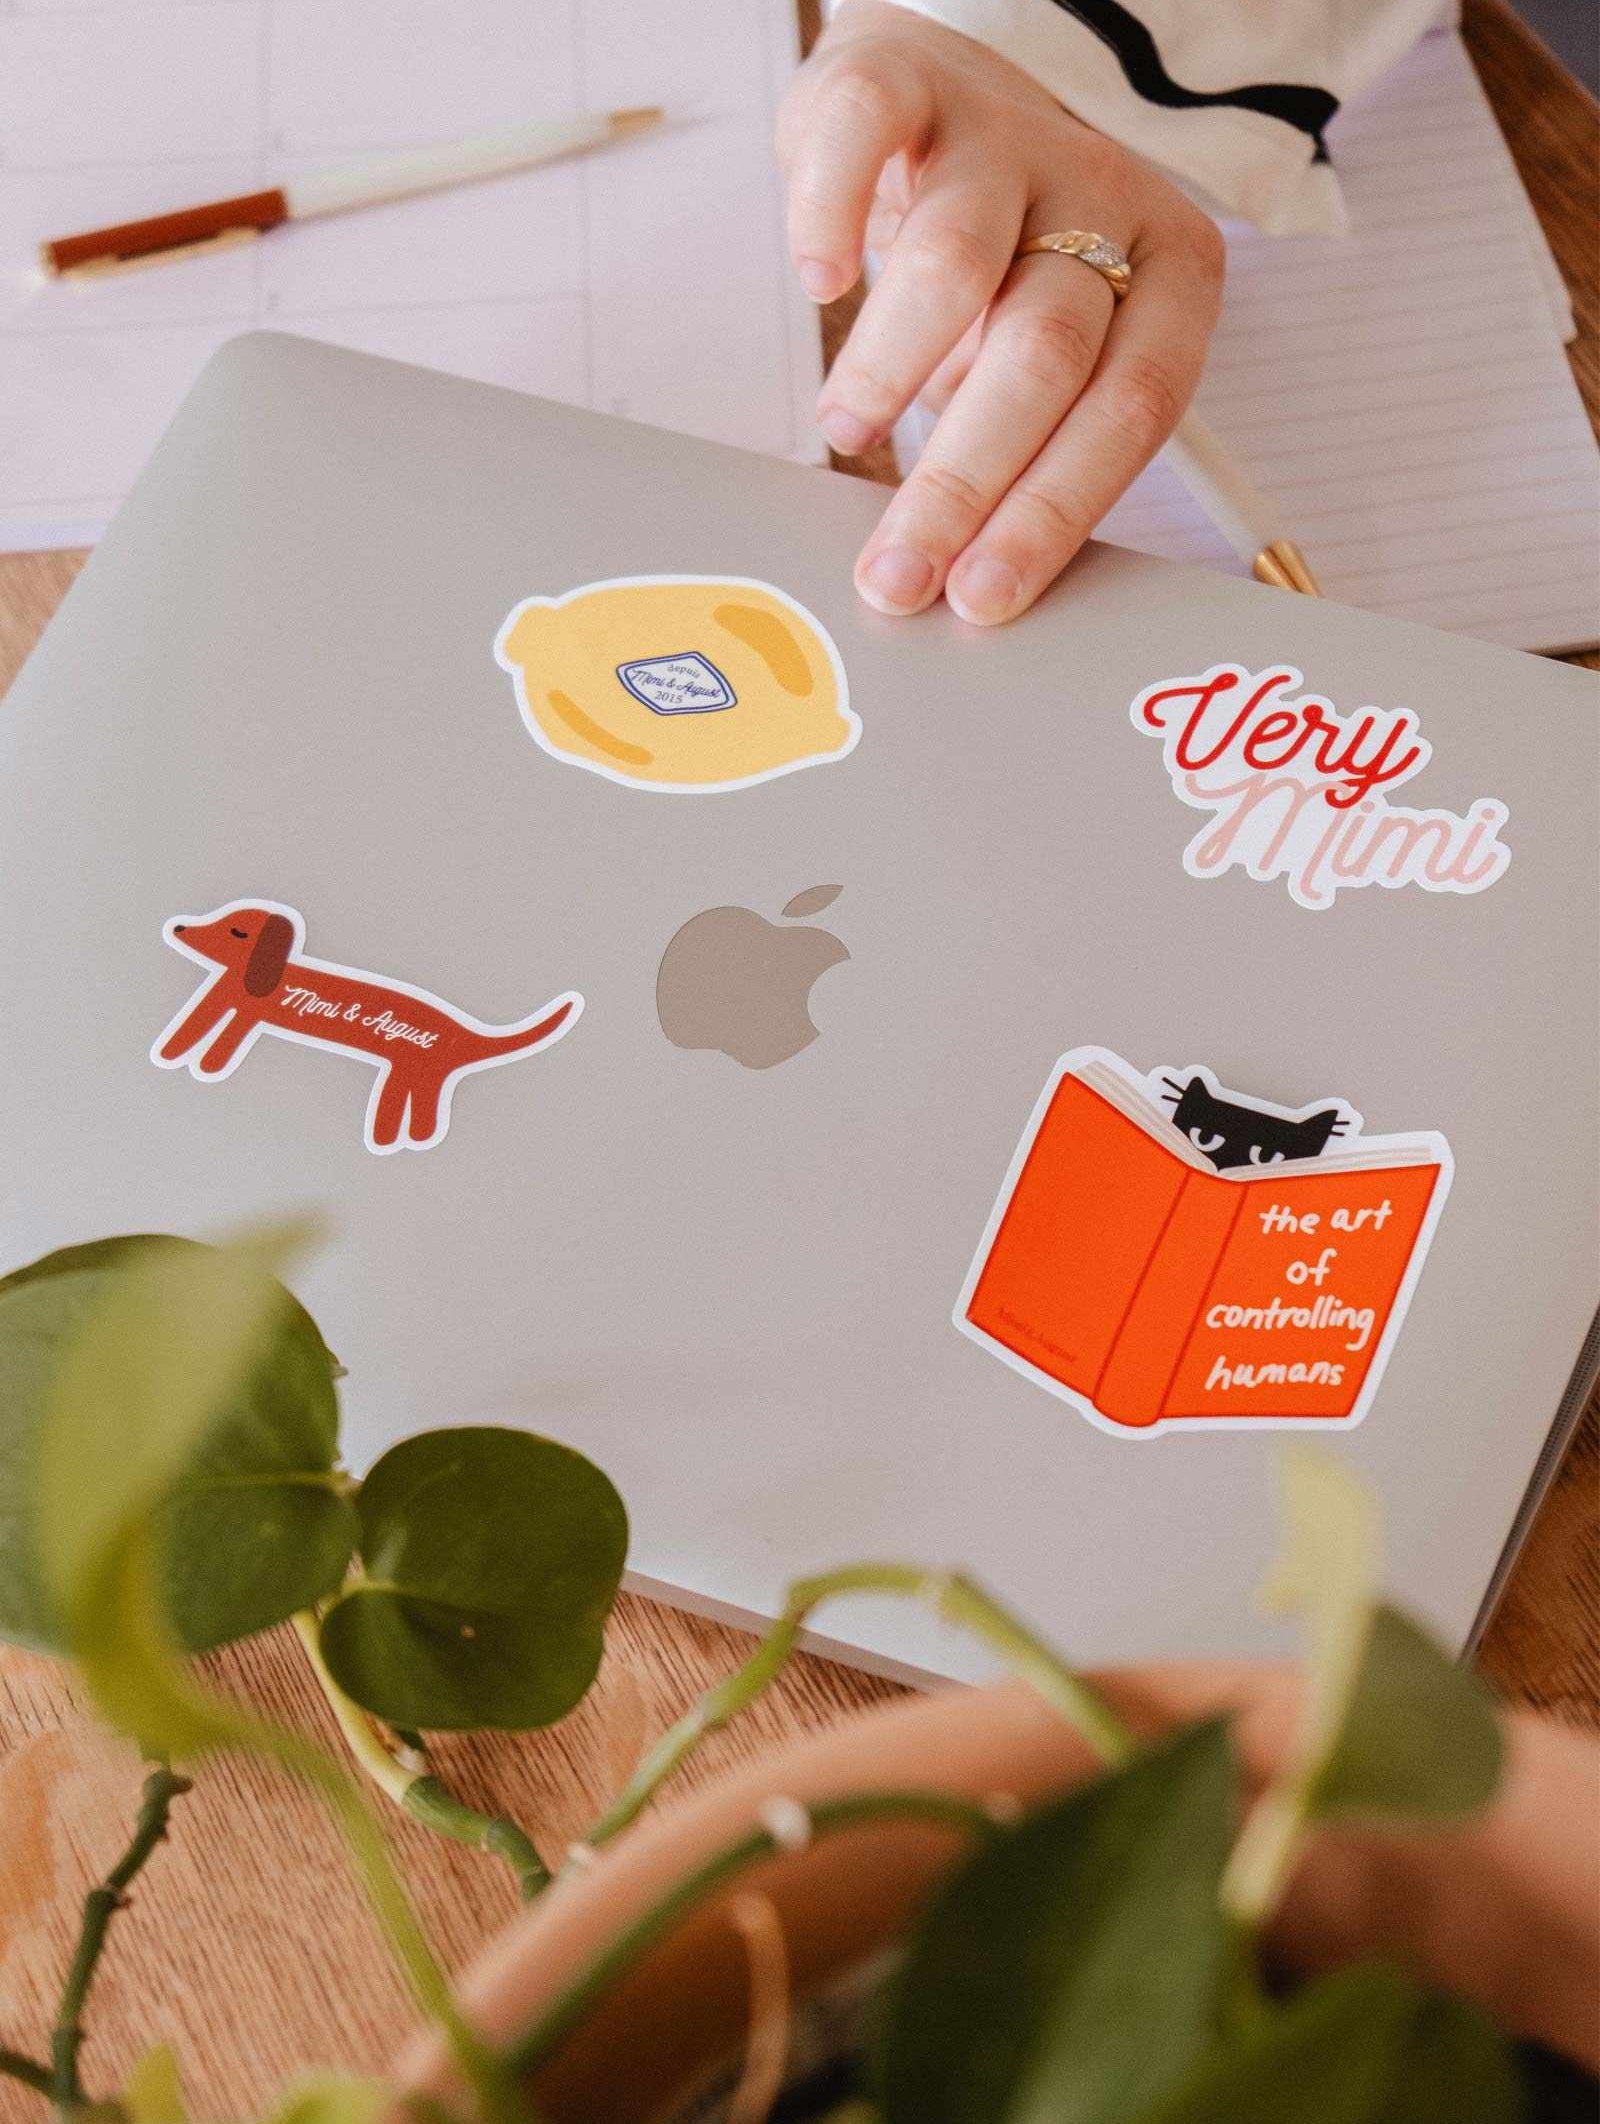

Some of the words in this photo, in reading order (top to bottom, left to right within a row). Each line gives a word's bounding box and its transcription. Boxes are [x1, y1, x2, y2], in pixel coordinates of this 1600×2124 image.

[631, 669, 665, 687] Mimi
[666, 678, 676, 689] &
[676, 681, 721, 699] August
[667, 664, 701, 679] depuis
[655, 690, 683, 704] 2015
[1143, 672, 1421, 810] Very
[1184, 771, 1499, 901] Mimi
[281, 984, 342, 1017] Mimi
[343, 1003, 362, 1022] &
[362, 1010, 439, 1049] August
[1258, 1203, 1321, 1235] the
[1330, 1199, 1393, 1232] art
[1285, 1247, 1338, 1287] of
[1205, 1294, 1376, 1351] controlling
[1204, 1354, 1346, 1391] humans
